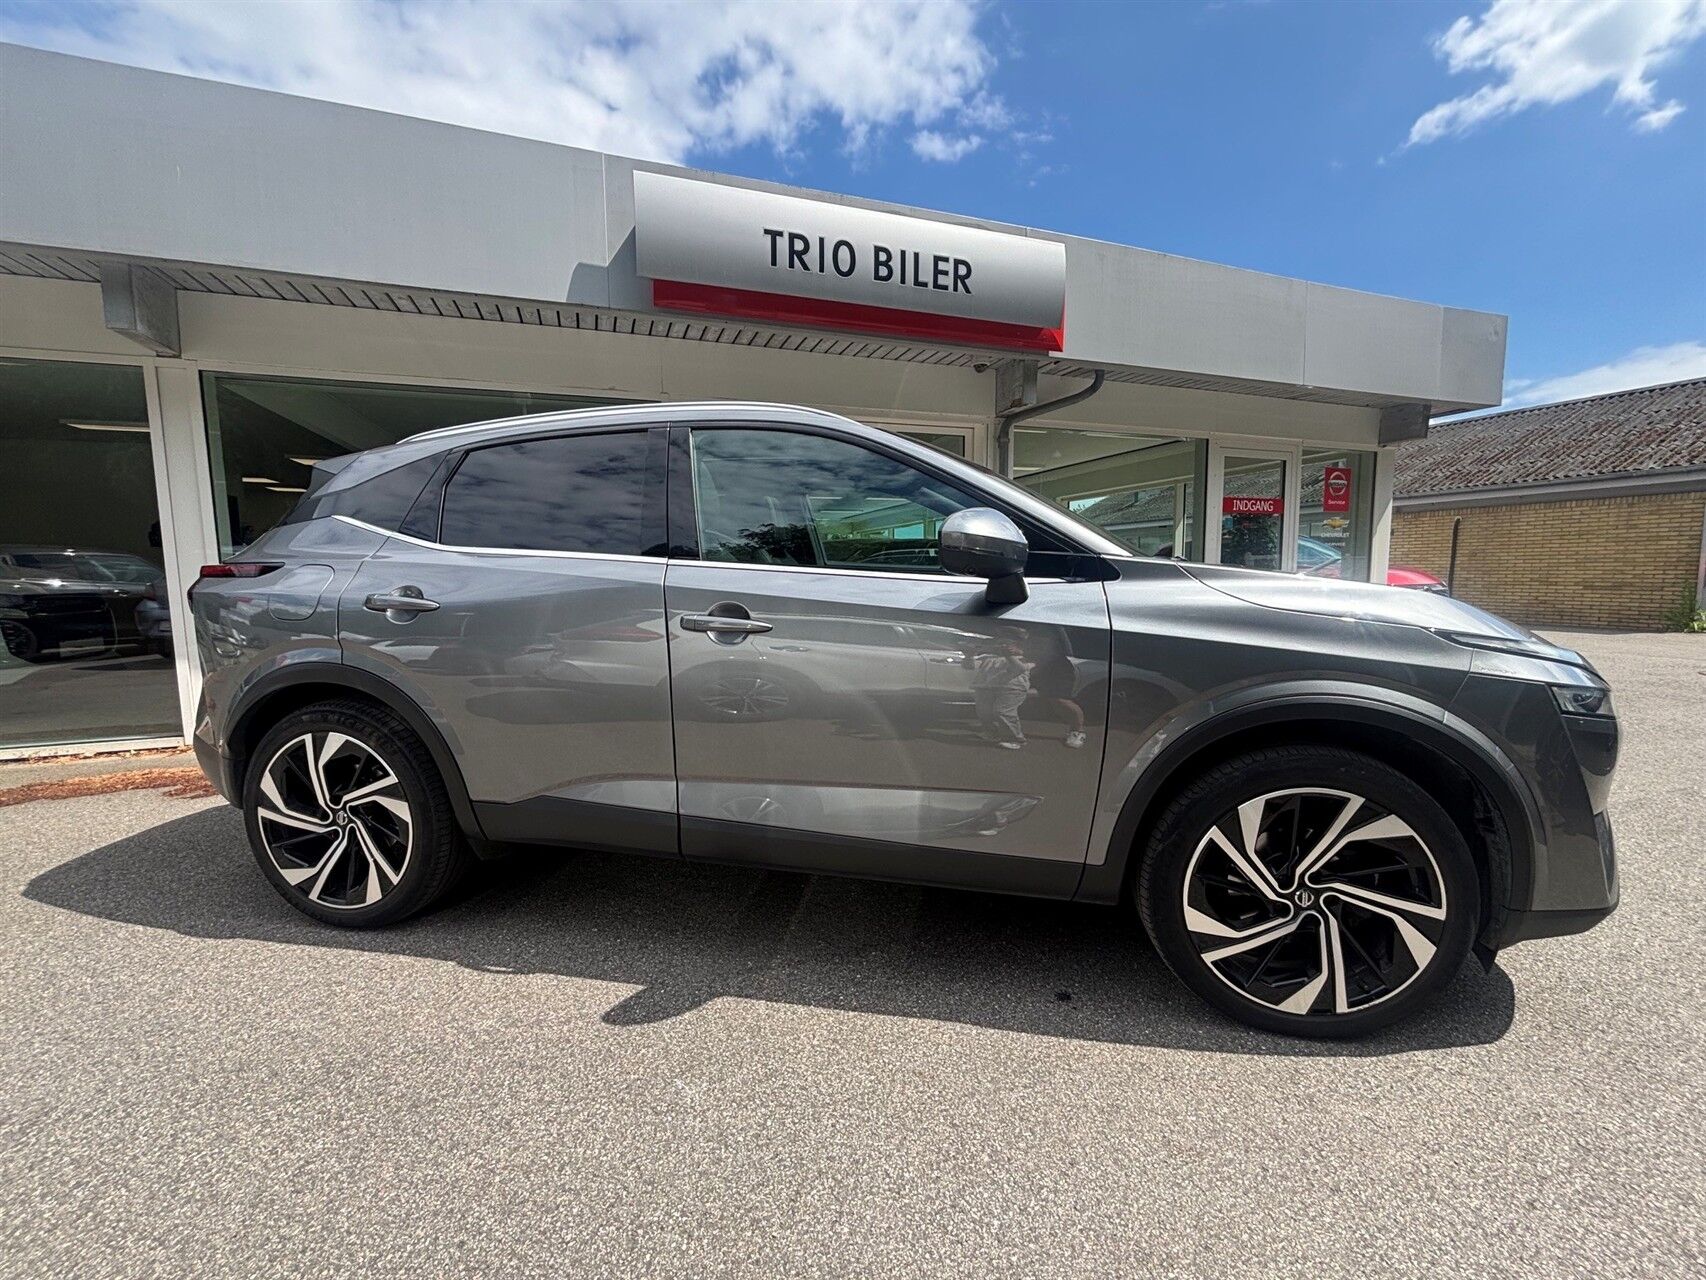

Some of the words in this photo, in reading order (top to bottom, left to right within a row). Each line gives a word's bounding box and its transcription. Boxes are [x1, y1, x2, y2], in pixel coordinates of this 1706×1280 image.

[763, 228, 857, 277] TRIO
[873, 244, 973, 294] BILER
[1232, 499, 1274, 512] INDGANG
